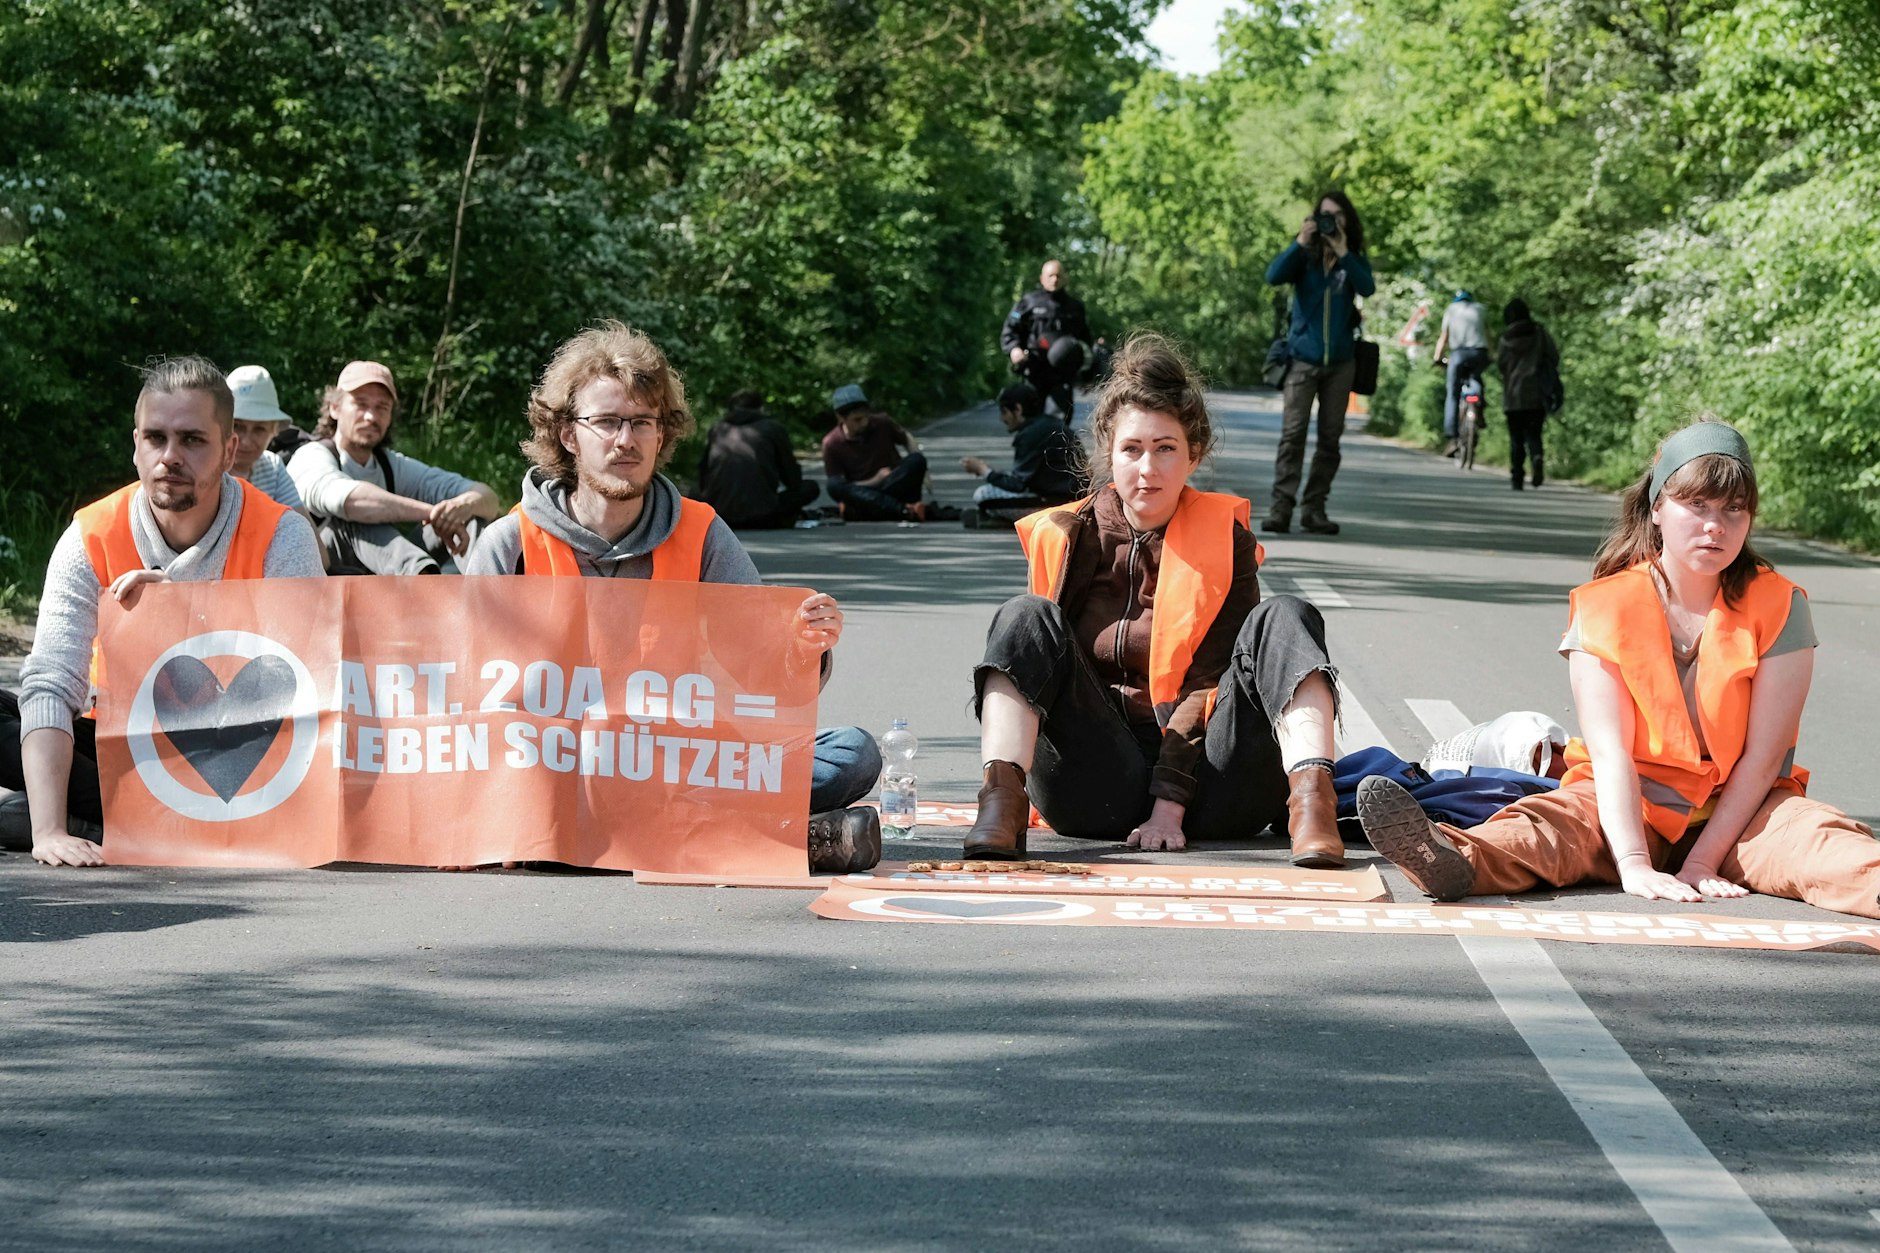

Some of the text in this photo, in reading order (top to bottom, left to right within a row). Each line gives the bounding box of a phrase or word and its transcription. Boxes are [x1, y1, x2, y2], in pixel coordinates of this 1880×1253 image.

[329, 659, 777, 729] ART. 20A GG =
[332, 721, 783, 793] LEBEN SCHÜTZEN
[1110, 911, 1880, 944] VOR DEN KIPPPUN
[1114, 902, 1436, 920] LETZTE
